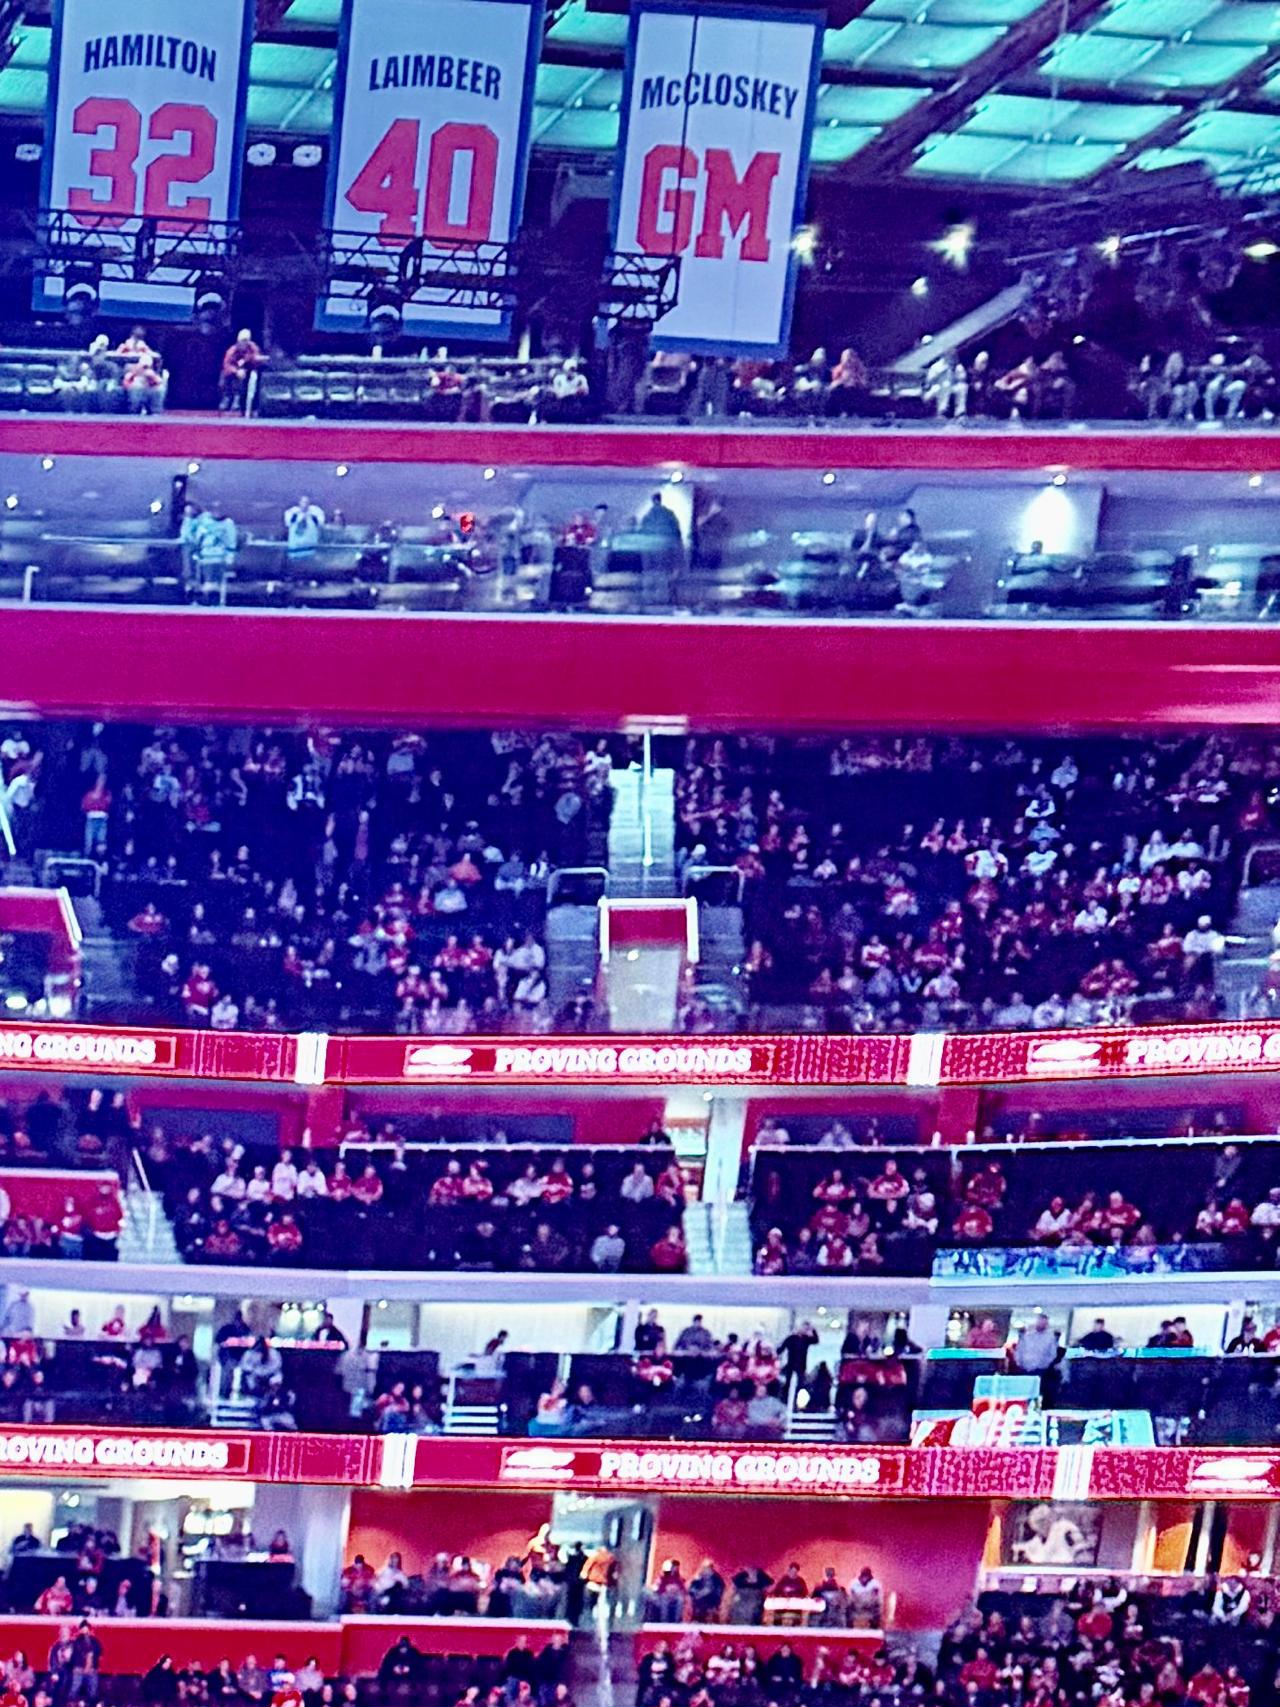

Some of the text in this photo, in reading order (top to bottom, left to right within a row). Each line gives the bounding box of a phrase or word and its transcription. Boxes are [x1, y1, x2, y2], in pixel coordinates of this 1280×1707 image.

[83, 33, 217, 82] HAMILTON
[368, 54, 502, 100] LAIMBEER
[640, 73, 800, 120] McCLOSKEY
[68, 97, 218, 233] 32
[344, 118, 500, 251] 40
[635, 144, 782, 262] GM
[33, 1033, 158, 1065] GROUNDS
[493, 1047, 753, 1073] PROVING GROUNDS
[95, 1438, 229, 1469] GROUNDS
[600, 1452, 881, 1485] PROVING GROUNDS
